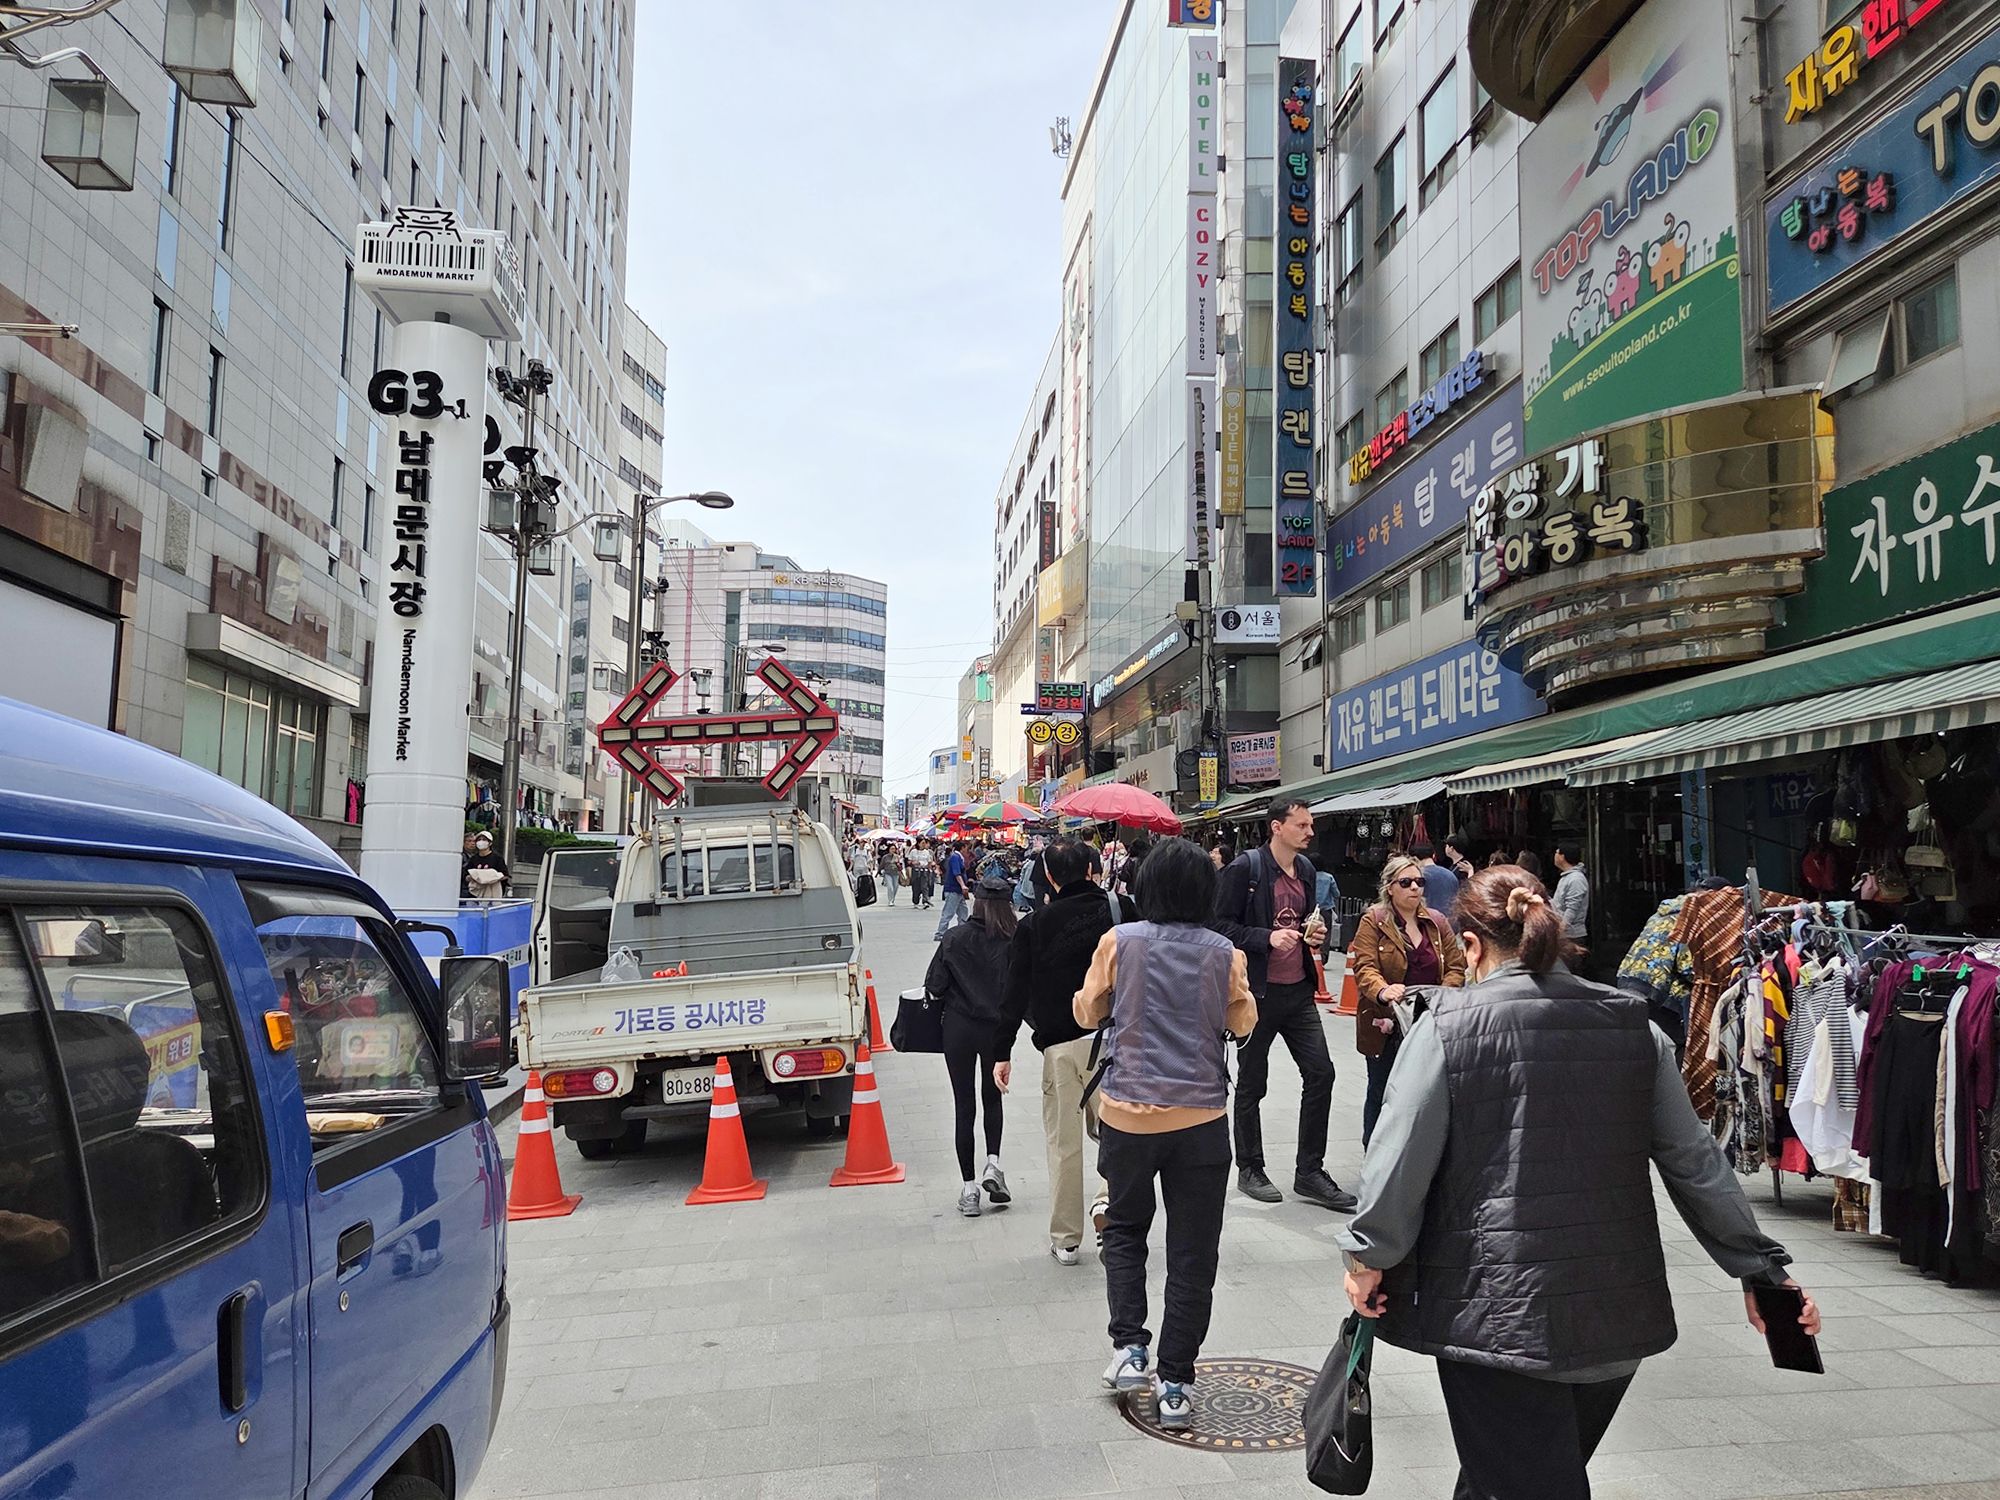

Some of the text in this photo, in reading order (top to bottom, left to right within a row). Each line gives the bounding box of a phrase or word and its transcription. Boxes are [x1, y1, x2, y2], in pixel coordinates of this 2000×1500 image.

[1785, 0, 1942, 124] 자유 핸
[1197, 72, 1210, 177] HOTEL
[1197, 208, 1209, 288] COZY
[1289, 152, 1308, 317] 탑나는 아동복
[377, 268, 475, 281] AMDAEMUN MARKET
[1562, 301, 1692, 401] www.seoultopland.co.kr
[1227, 413, 1238, 462] HOTEL
[1282, 350, 1312, 497] 탑랜드
[1349, 444, 1372, 486] 자유
[1370, 410, 1408, 470] 핸드백
[1368, 500, 1404, 545] 아동복
[1414, 421, 1517, 528] 탑랜드
[1466, 439, 1603, 550] 유상가
[390, 430, 434, 618] 남대문시장
[1278, 535, 1315, 548] LAND
[1282, 517, 1312, 529] TOP
[1282, 561, 1312, 582] 2F
[1244, 610, 1280, 626] 서울
[396, 628, 417, 761] Namdaemoon Market
[1039, 697, 1083, 710] 안경원
[1041, 684, 1081, 697] 굿모닝
[1338, 649, 1501, 753] 자유 핸드백 도매타운
[168, 1034, 192, 1062] 위험
[615, 999, 766, 1034] 가로등 공사차량
